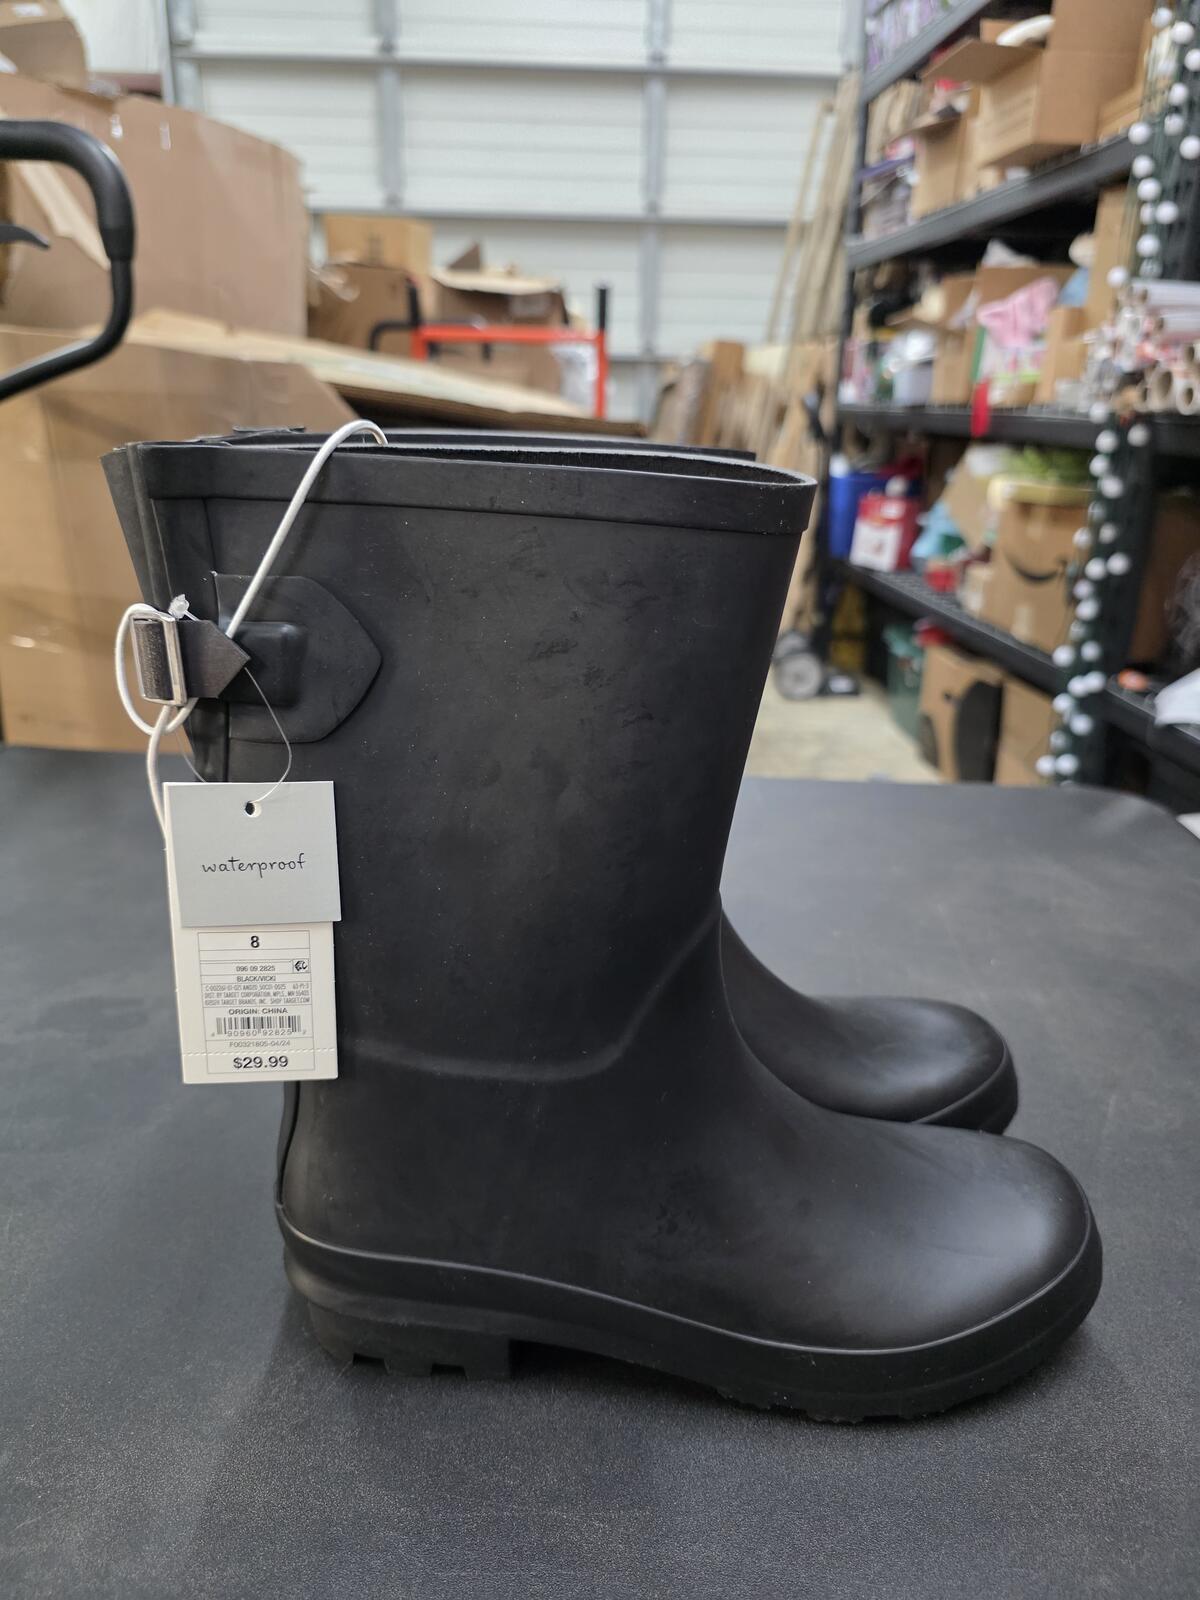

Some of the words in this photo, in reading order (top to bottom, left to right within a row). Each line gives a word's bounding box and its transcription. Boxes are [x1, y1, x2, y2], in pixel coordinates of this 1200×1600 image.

[202, 853, 307, 878] waterproof
[250, 935, 260, 948] 8
[233, 1055, 289, 1069] $29.99
